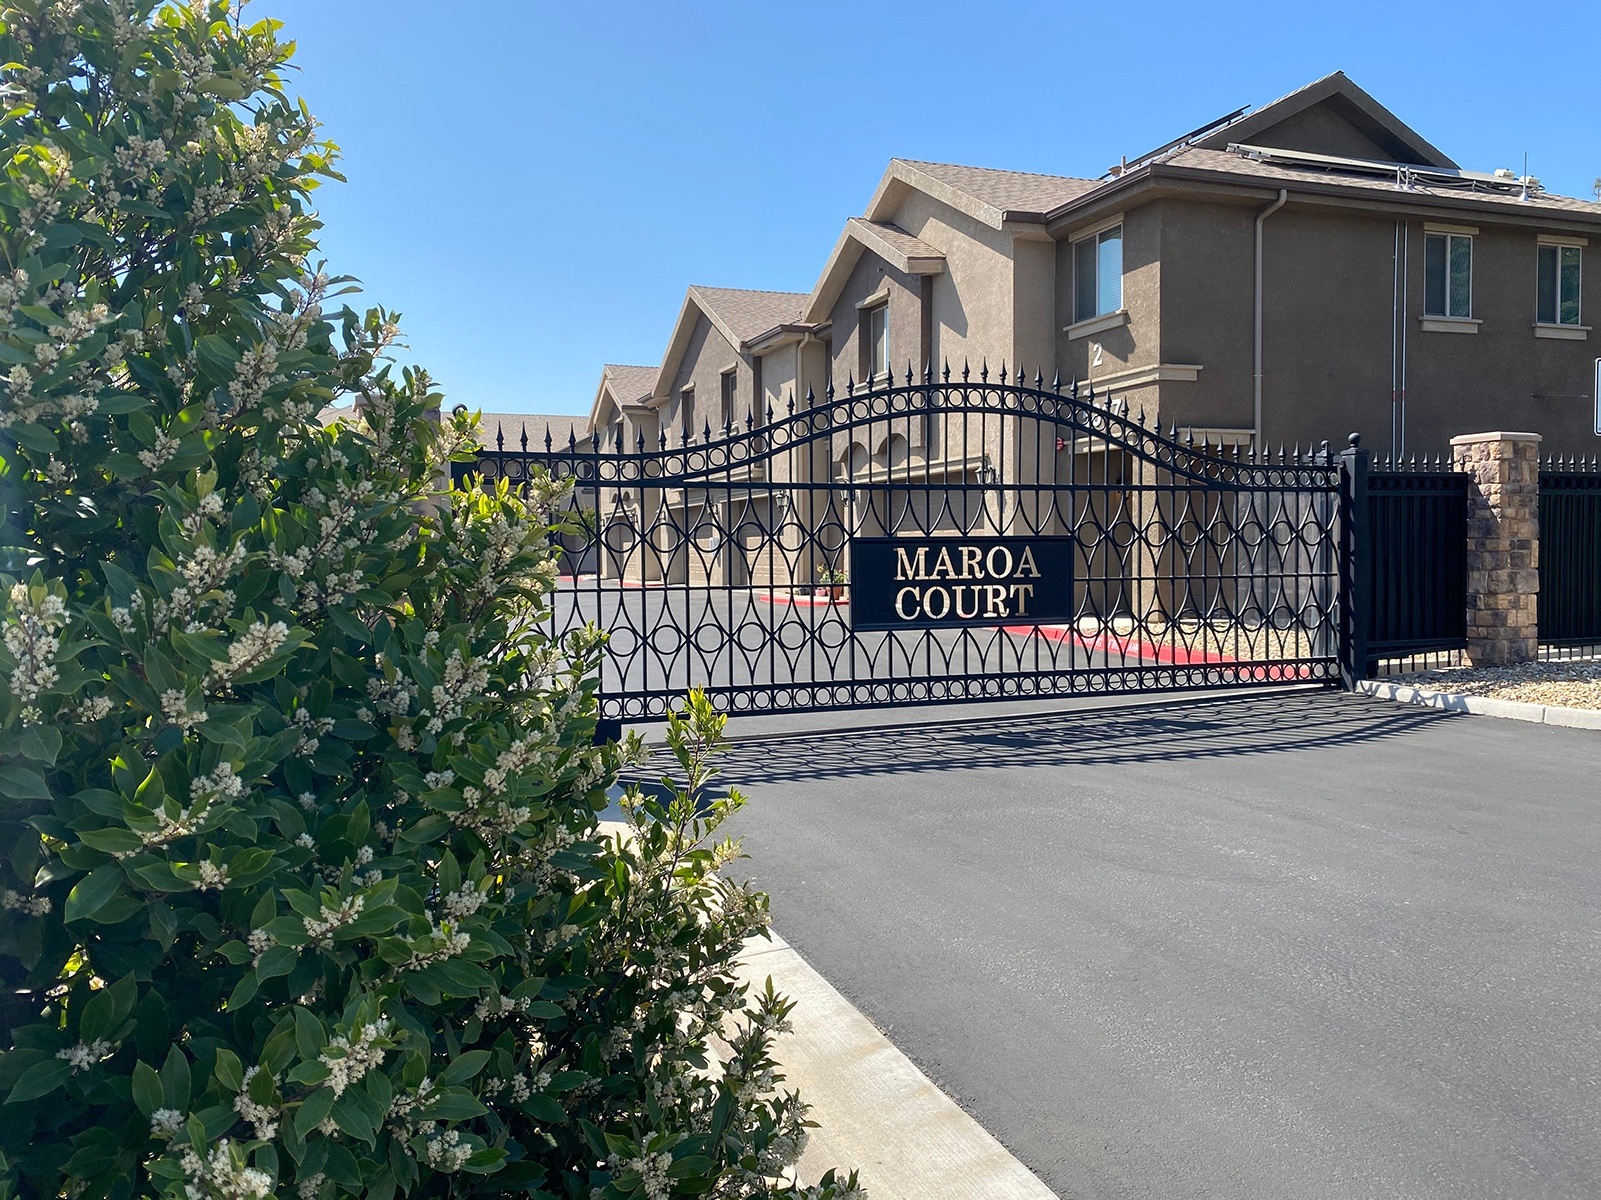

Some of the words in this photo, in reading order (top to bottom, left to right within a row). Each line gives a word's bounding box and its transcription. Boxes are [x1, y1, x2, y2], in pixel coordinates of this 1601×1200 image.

[1093, 342, 1103, 367] 2
[893, 545, 1042, 581] MAROA
[895, 584, 1034, 620] COURT
